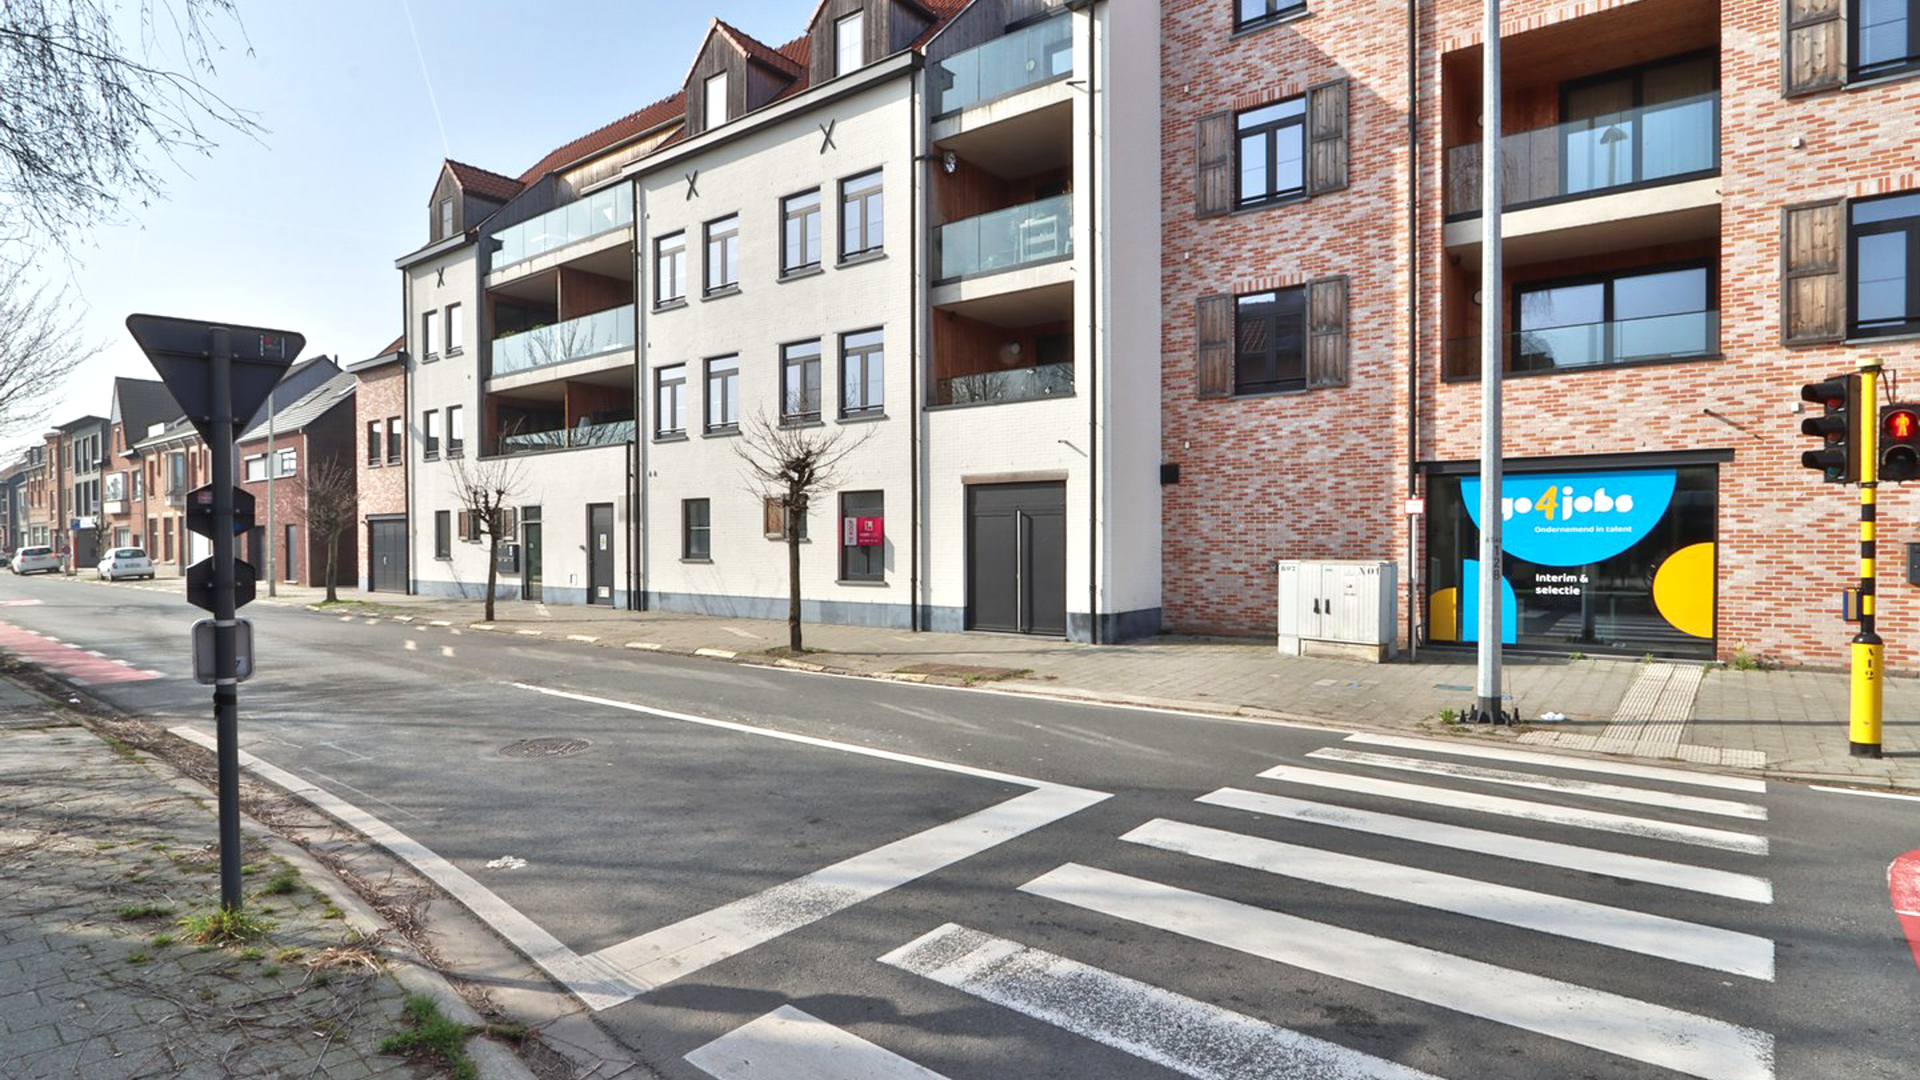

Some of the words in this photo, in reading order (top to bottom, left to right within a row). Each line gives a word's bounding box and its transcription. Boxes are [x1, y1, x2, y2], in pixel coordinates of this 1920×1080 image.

[1534, 525, 1595, 533] Ondernemend
[1595, 525, 1605, 533] in
[1605, 525, 1633, 533] talent
[1535, 573, 1578, 582] Interim
[1579, 574, 1589, 583] &
[1535, 585, 1581, 595] selectie
